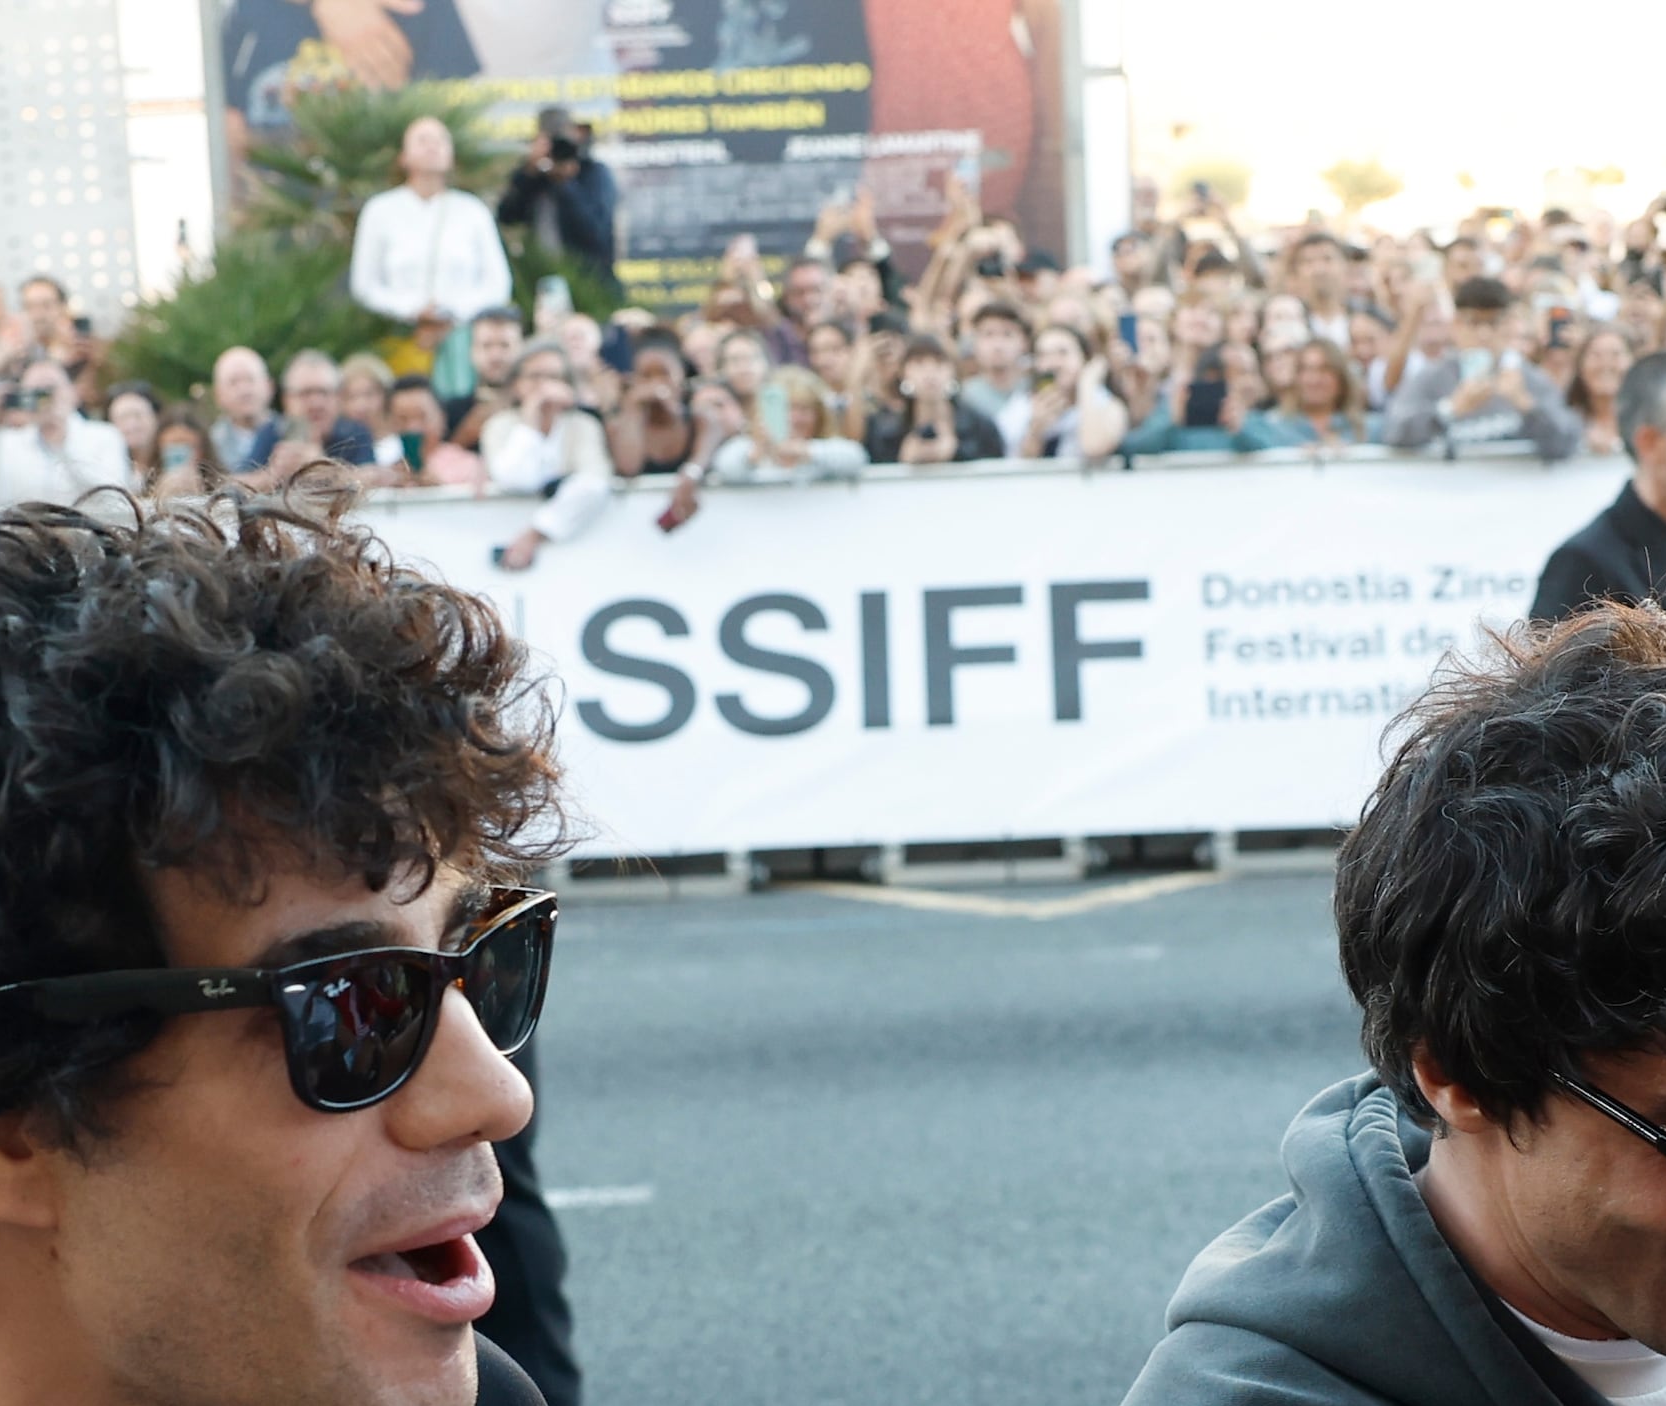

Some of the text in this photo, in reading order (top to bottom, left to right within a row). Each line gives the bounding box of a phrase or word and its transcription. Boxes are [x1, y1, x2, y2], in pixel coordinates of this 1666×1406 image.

[1200, 565, 1531, 611] Donostia Zine
[575, 580, 1151, 743] SSIFF
[1204, 626, 1386, 664] Festival
